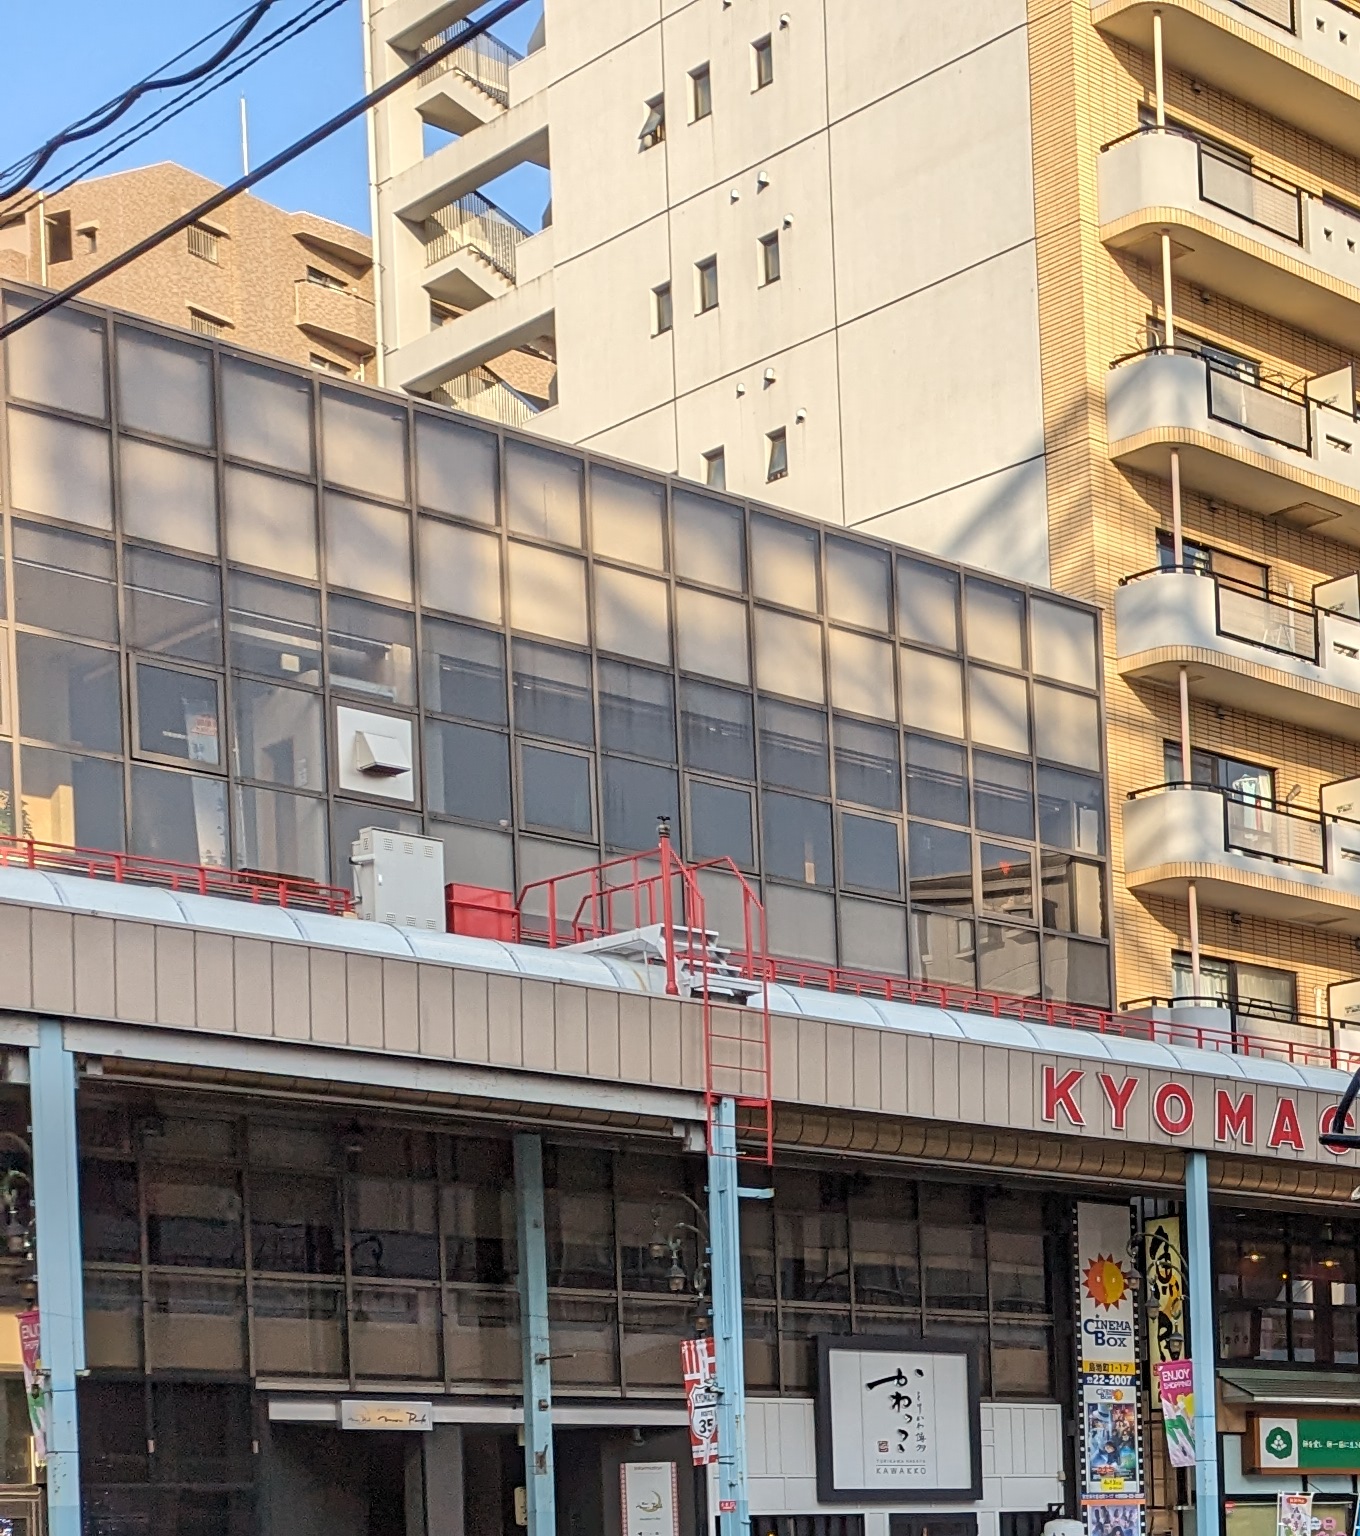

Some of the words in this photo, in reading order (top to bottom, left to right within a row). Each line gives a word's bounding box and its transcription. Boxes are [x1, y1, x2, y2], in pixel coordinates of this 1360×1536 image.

[1083, 1318, 1132, 1335] CINEMA
[1094, 1331, 1127, 1348] BOX
[1162, 1368, 1190, 1382] ENJOY
[699, 1419, 713, 1434] 35
[876, 1467, 927, 1475] KAWAKKO
